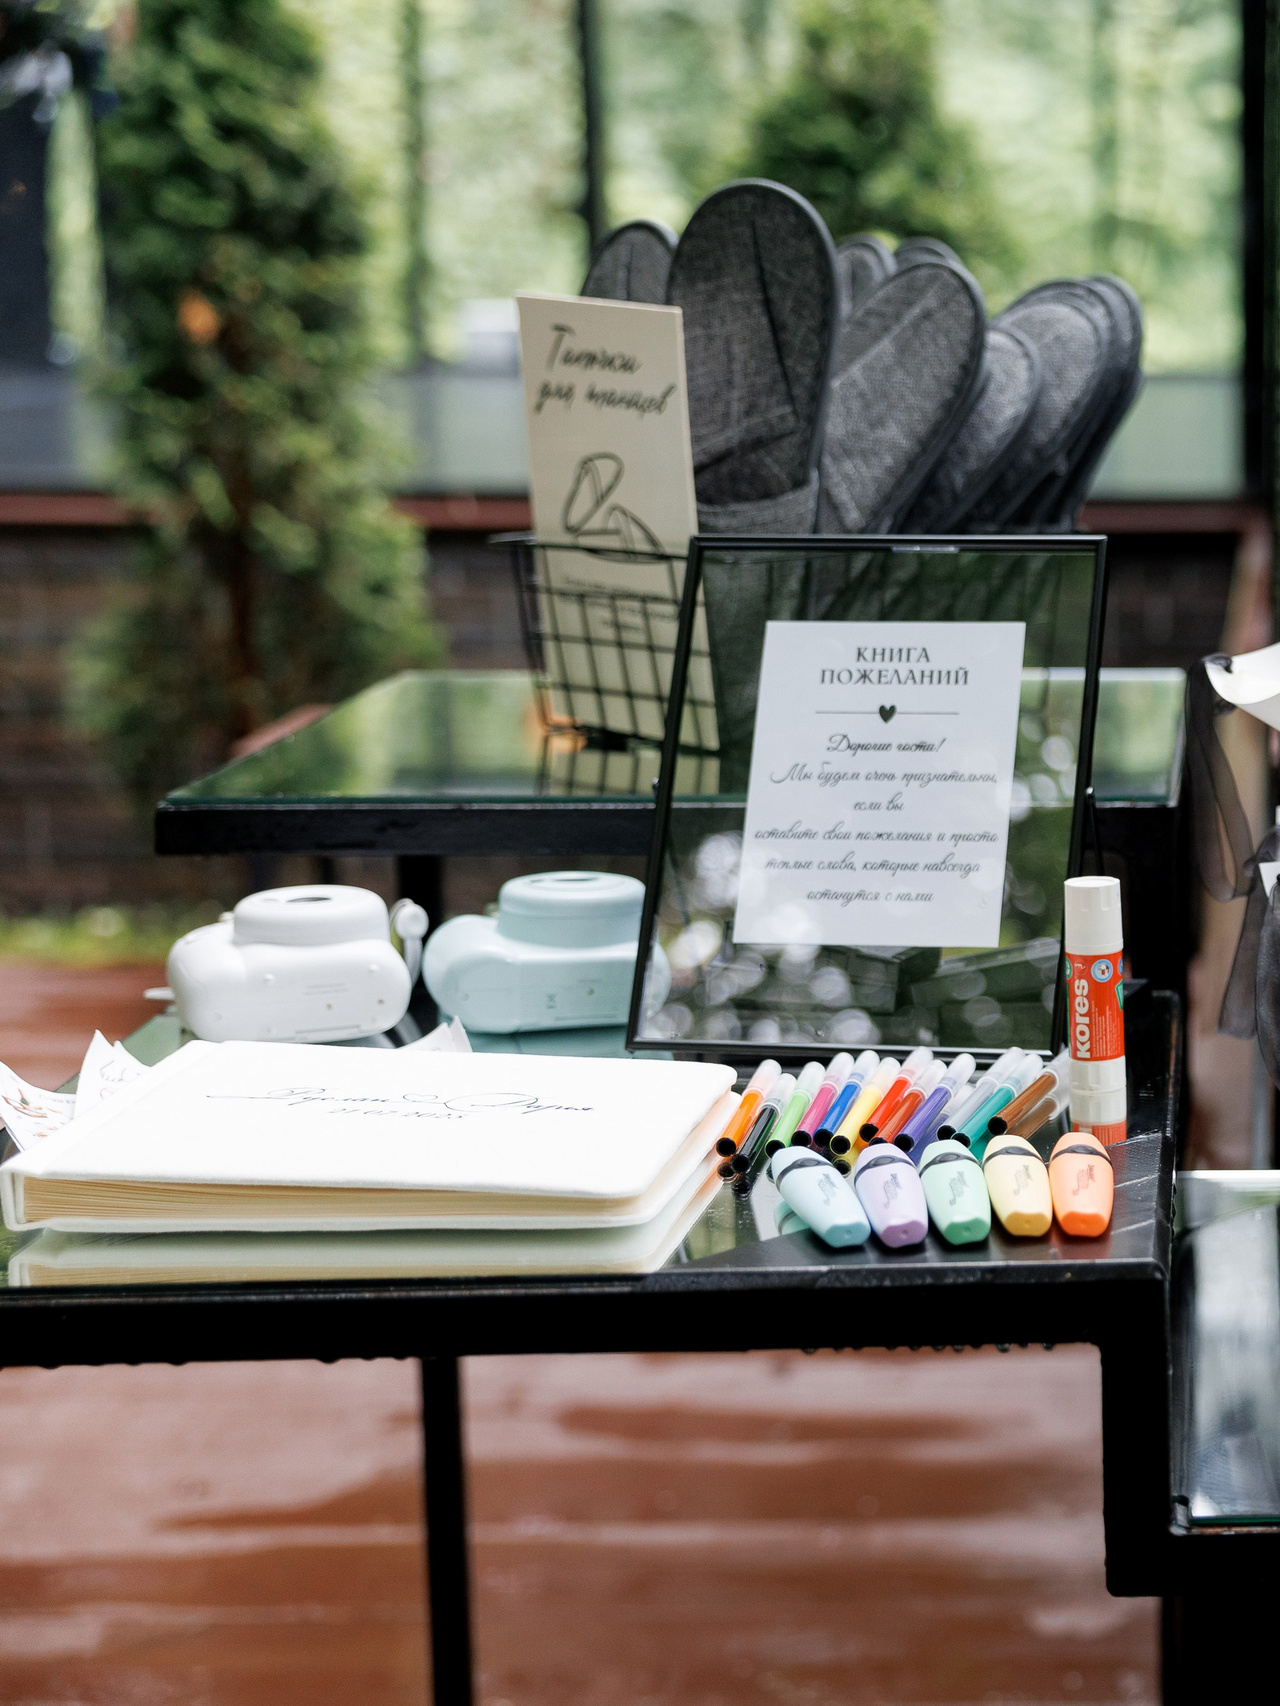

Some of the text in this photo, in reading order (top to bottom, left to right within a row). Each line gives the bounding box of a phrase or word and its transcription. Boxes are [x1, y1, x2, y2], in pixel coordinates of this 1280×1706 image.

[856, 647, 931, 663] КНИГА
[820, 666, 969, 686] ПОЖЕЛАНИЙ
[827, 733, 946, 756] Дорогие гости!
[770, 762, 998, 788] Мы будем очень признательны,
[853, 792, 904, 812] если вы
[755, 820, 998, 847] оставите свои пожелания и просто
[817, 851, 856, 872] слова,
[863, 859, 919, 876] которые
[923, 852, 981, 879] навсегда
[807, 889, 881, 907] останутся
[895, 891, 934, 902] нами
[1074, 978, 1091, 1059] kores
